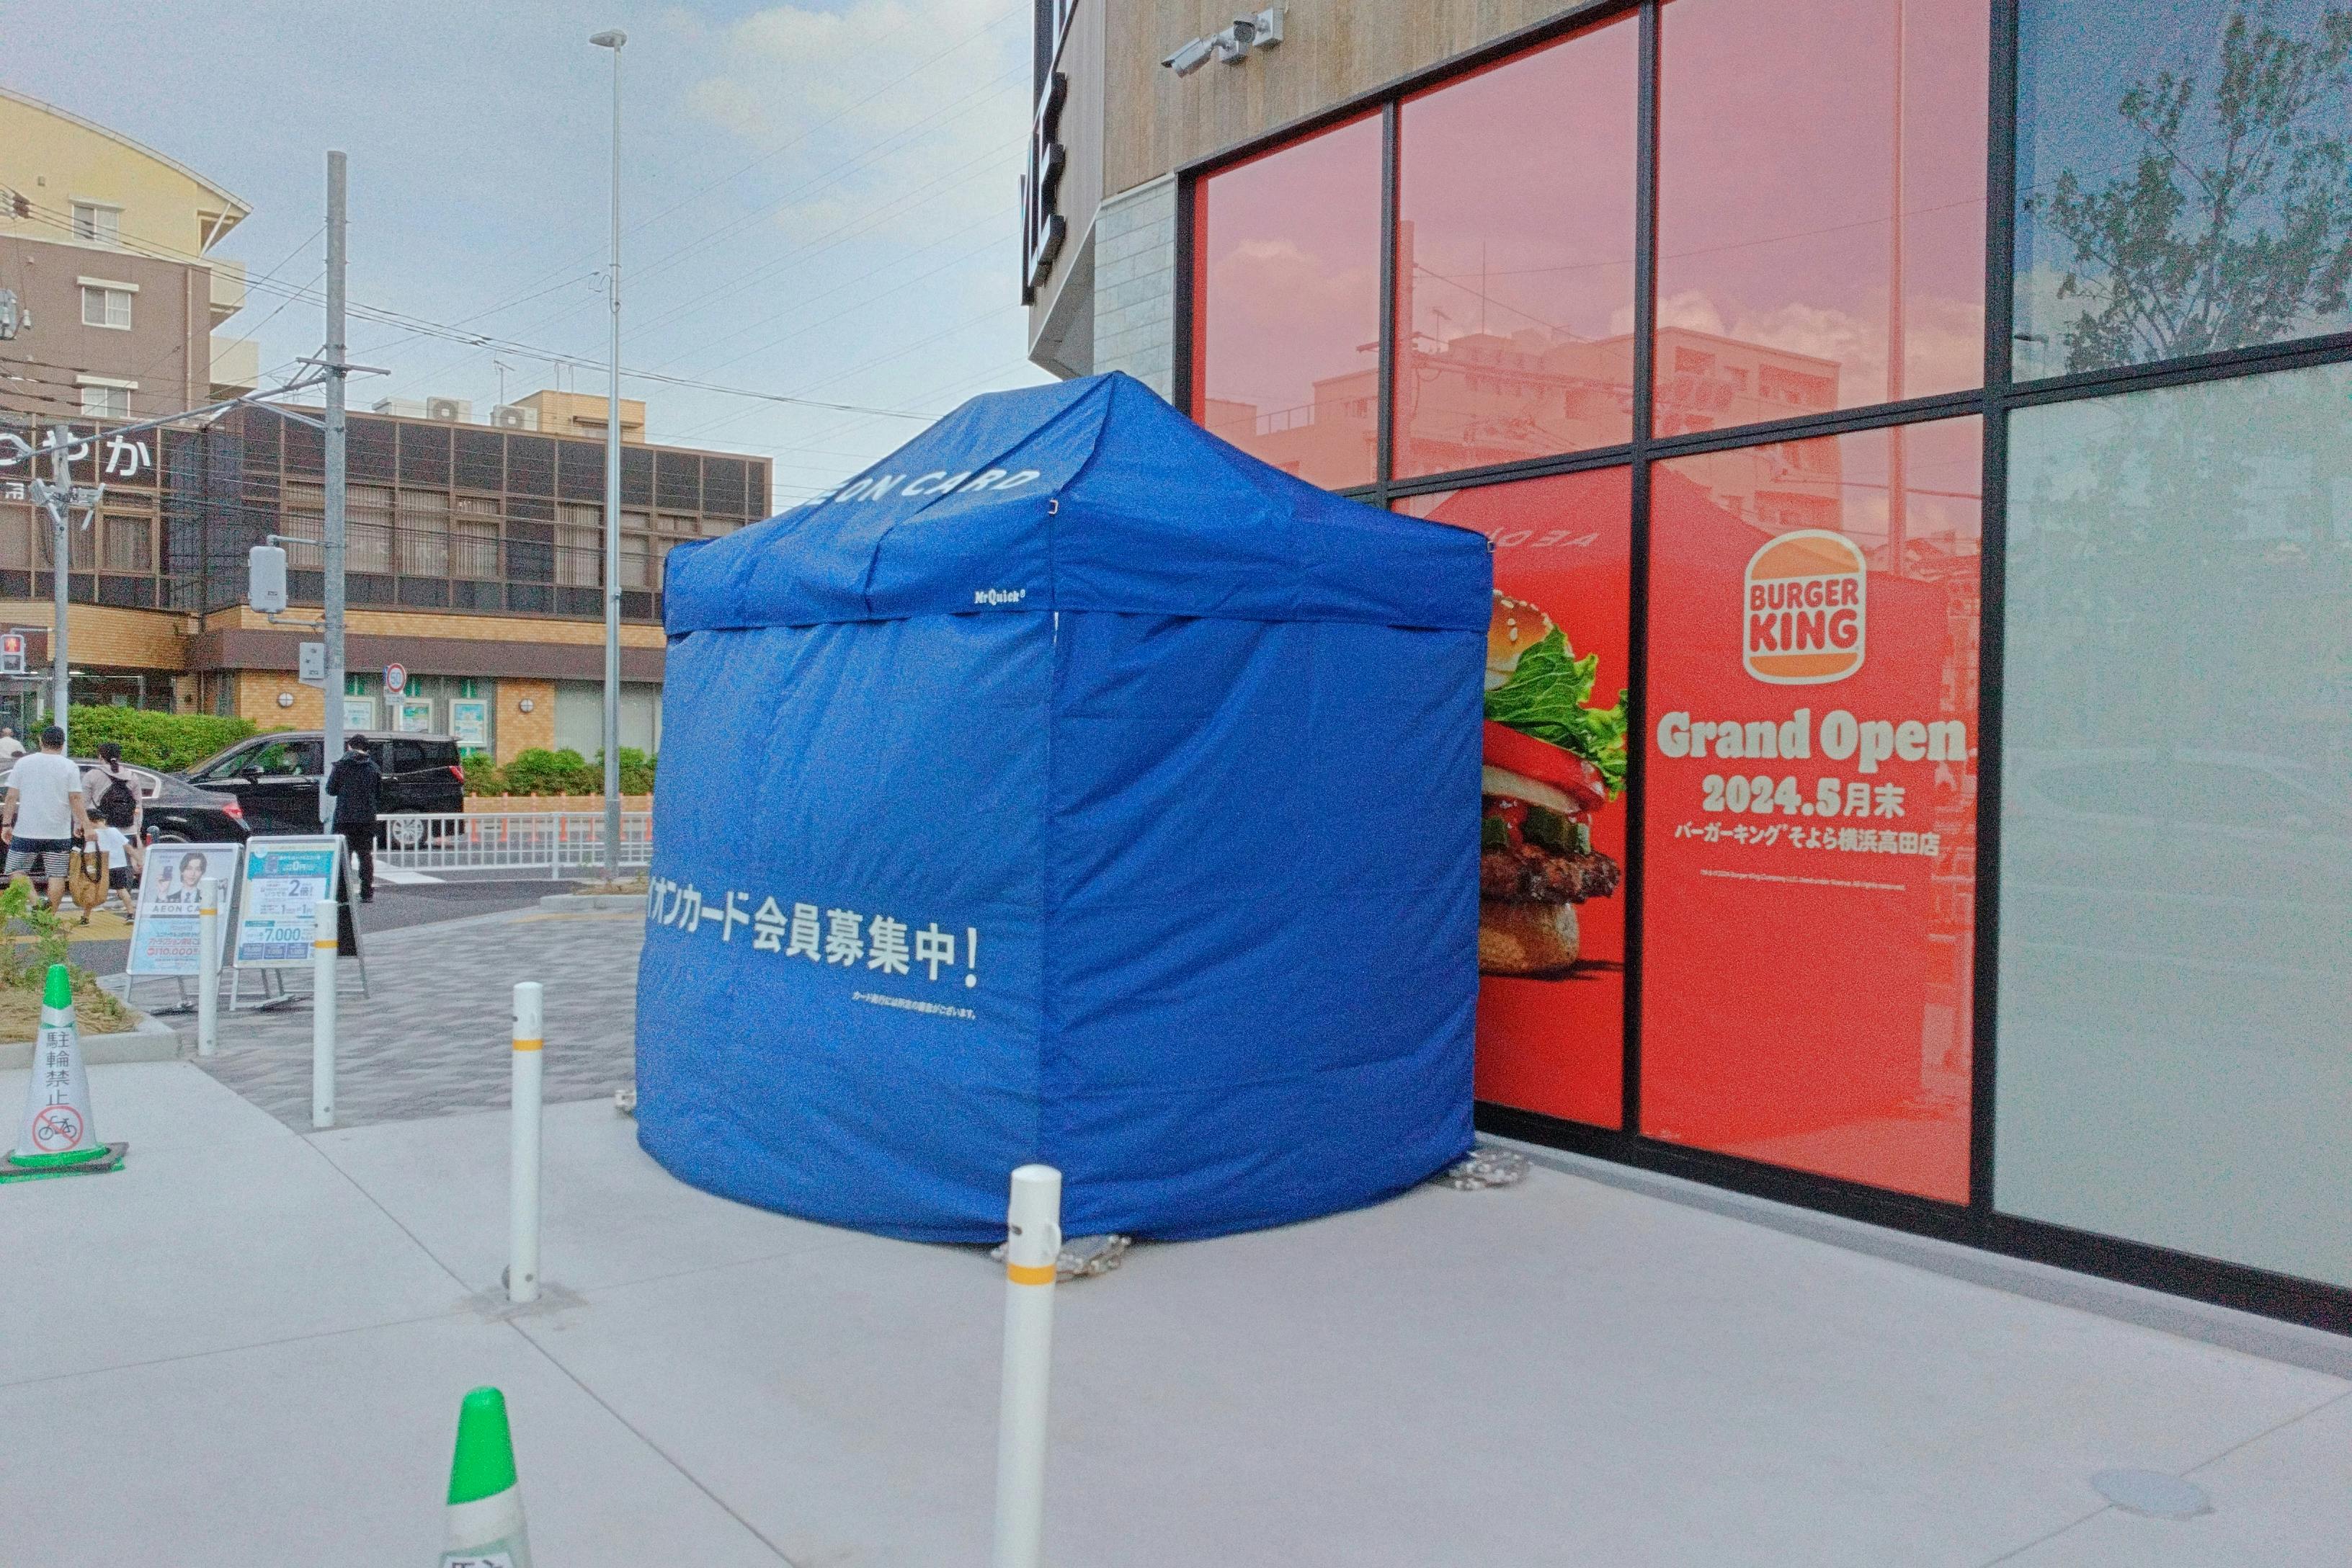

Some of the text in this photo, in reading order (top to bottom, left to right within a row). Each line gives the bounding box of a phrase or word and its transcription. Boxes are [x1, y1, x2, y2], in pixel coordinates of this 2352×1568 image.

[901, 469, 1041, 496] CARD
[1750, 578, 1859, 612] BURGER
[1749, 609, 1859, 652] KING
[1657, 708, 1966, 773] Grand Open
[1702, 775, 1905, 819] 2024.5月末
[265, 928, 301, 942] 7,000
[46, 1031, 70, 1106] 駐輪禁止
